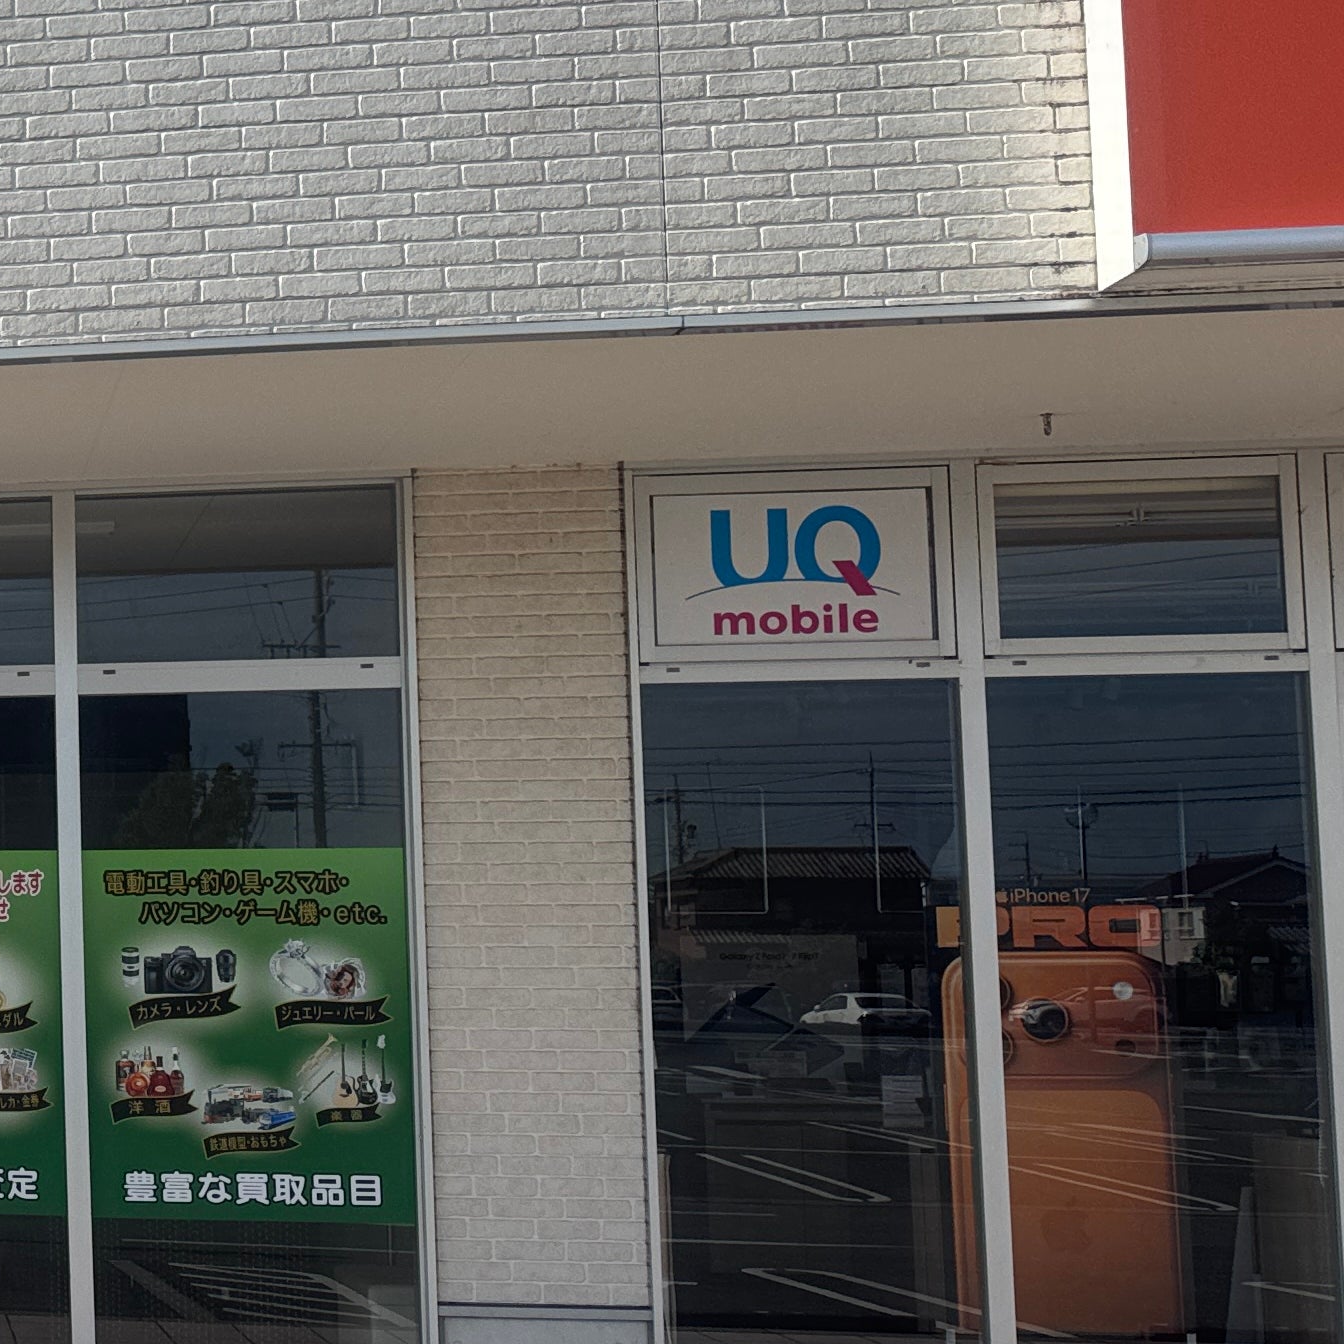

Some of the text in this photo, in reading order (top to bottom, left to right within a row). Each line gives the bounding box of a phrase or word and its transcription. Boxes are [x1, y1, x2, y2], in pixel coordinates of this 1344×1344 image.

[709, 505, 882, 597] UQ
[712, 603, 879, 637] mobile
[1009, 887, 1092, 903] iPhone 17
[136, 997, 223, 1022] カメラ・レンズ
[128, 1099, 171, 1115] 洋酒
[122, 1170, 383, 1207] 豊富な買取品目
